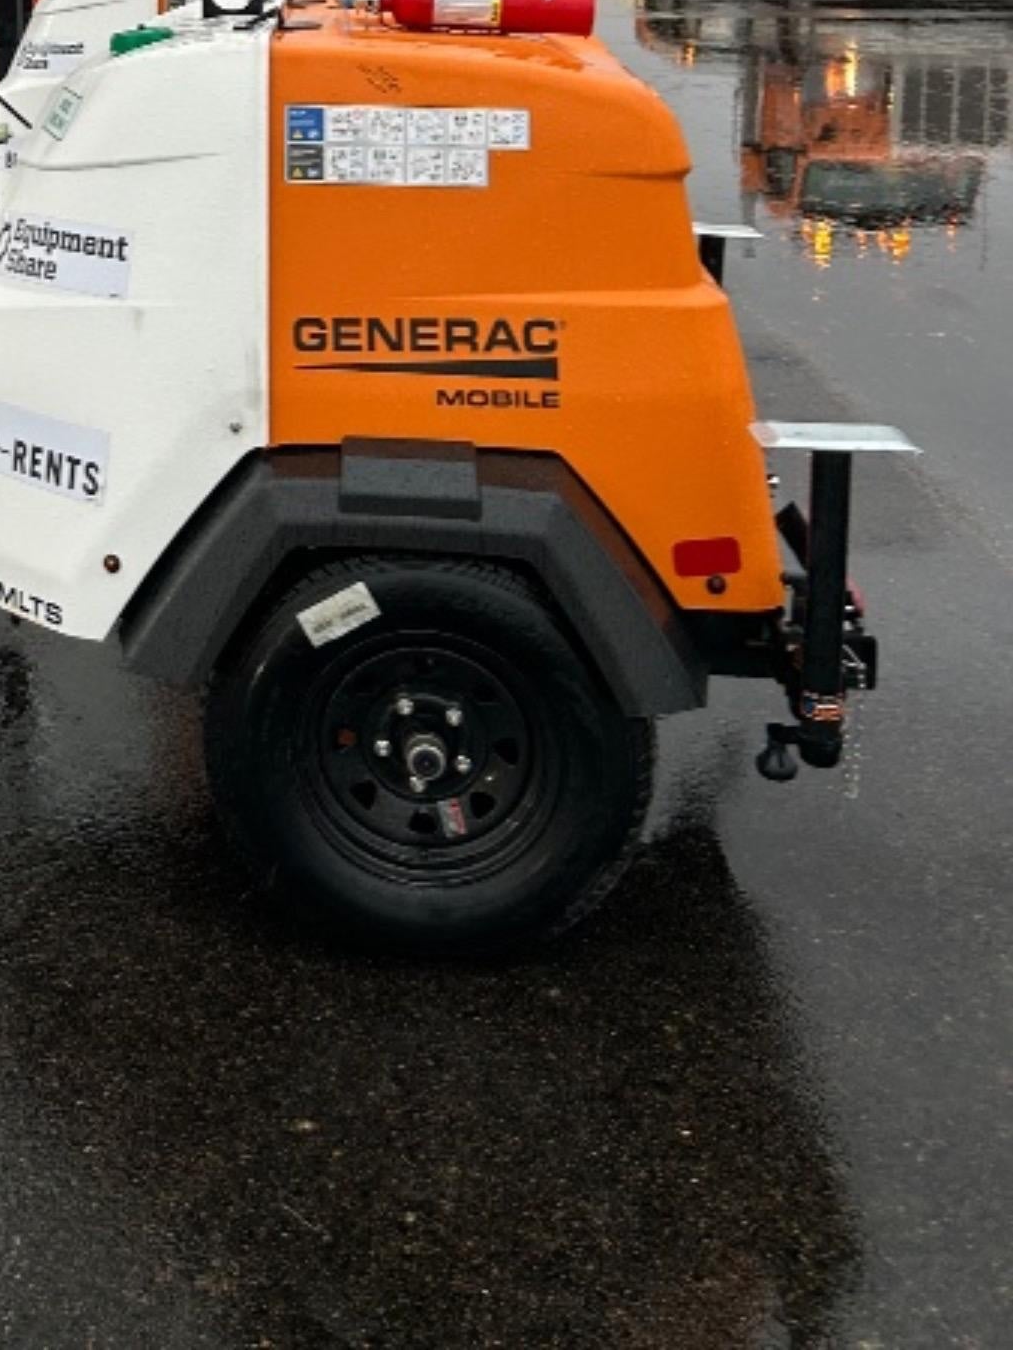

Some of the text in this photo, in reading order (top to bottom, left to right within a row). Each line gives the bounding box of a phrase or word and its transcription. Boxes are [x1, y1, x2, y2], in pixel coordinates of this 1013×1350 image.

[14, 218, 128, 261] Equipment
[6, 249, 57, 279] Share
[293, 317, 559, 352] GENERAC
[436, 389, 561, 408] MOBILE
